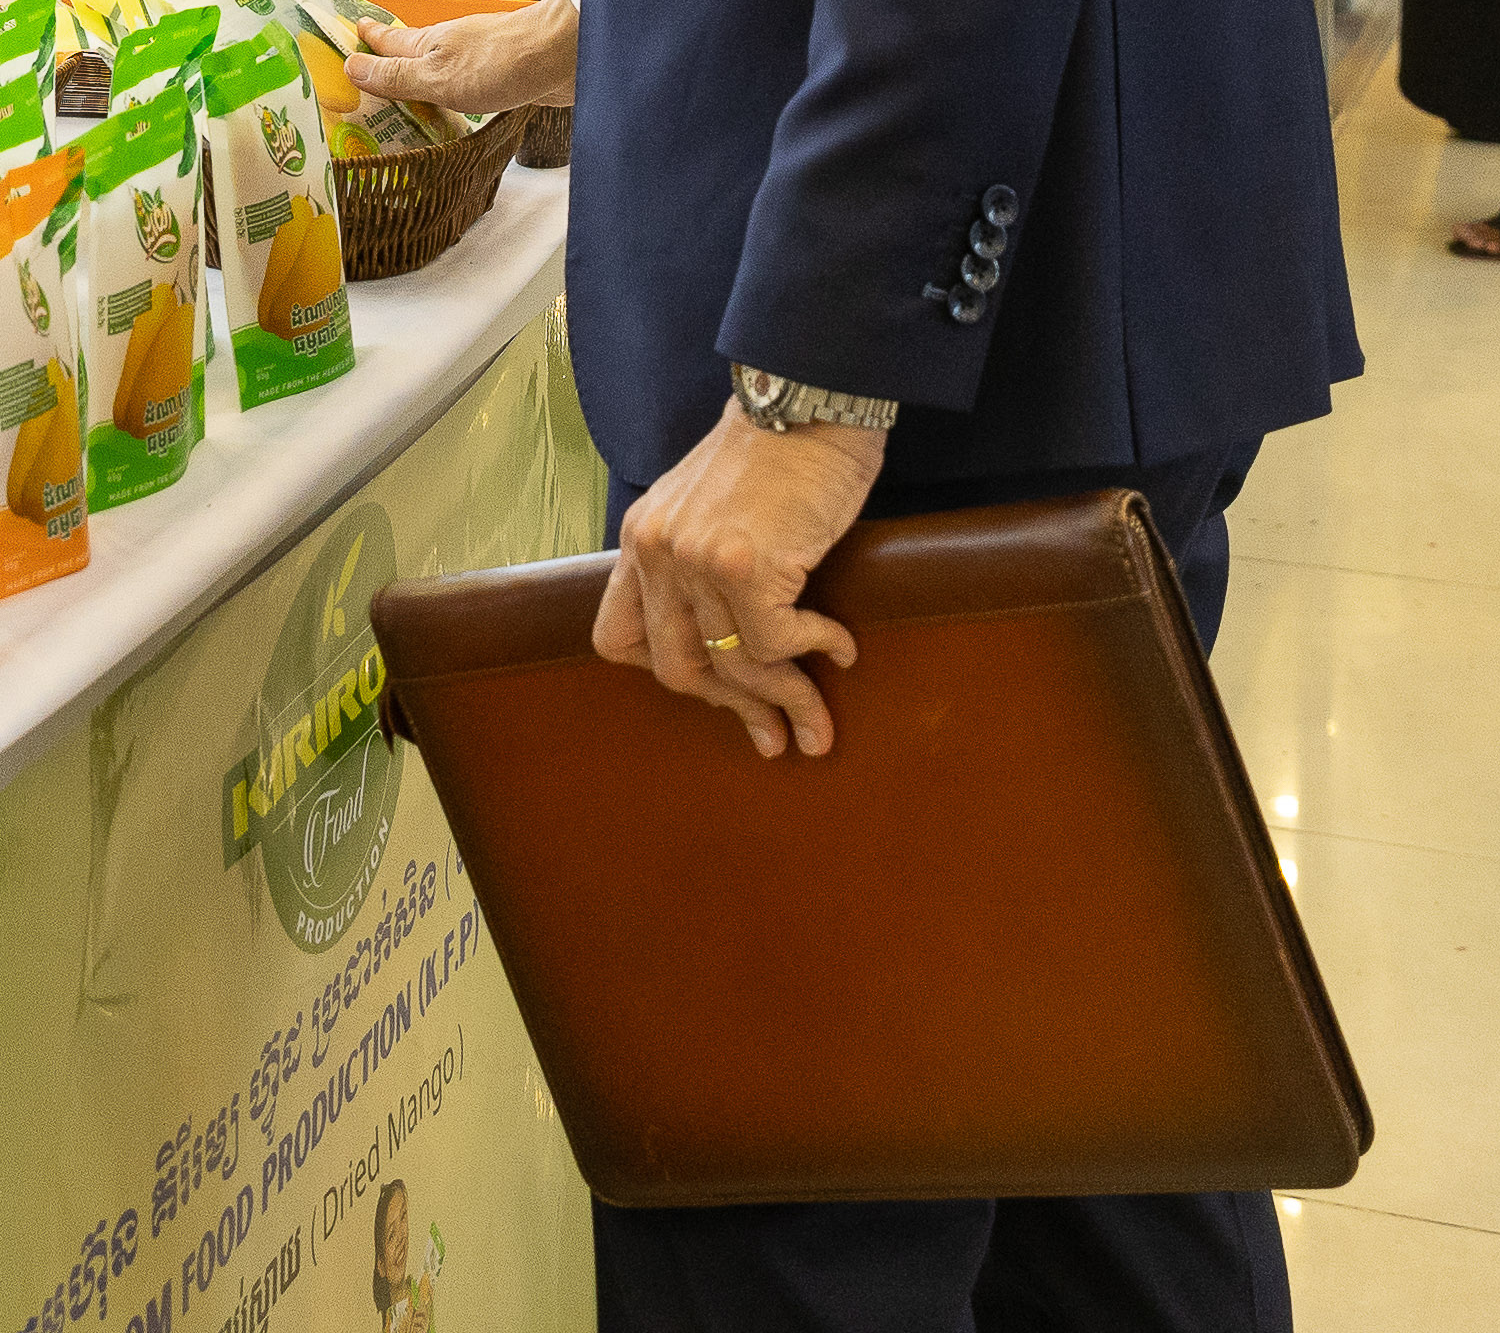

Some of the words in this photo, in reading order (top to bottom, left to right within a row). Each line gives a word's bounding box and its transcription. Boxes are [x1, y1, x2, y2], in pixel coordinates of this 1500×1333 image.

[232, 644, 387, 841] KIRIRO
[303, 729, 384, 888] Food
[296, 816, 390, 944] PRODUCTION
[181, 1184, 254, 1317] FOOD
[261, 980, 412, 1216] PRODUCTION
[419, 900, 479, 1017] (K.F.P)
[323, 1124, 381, 1241] Dried
[387, 1047, 455, 1160] Mango
